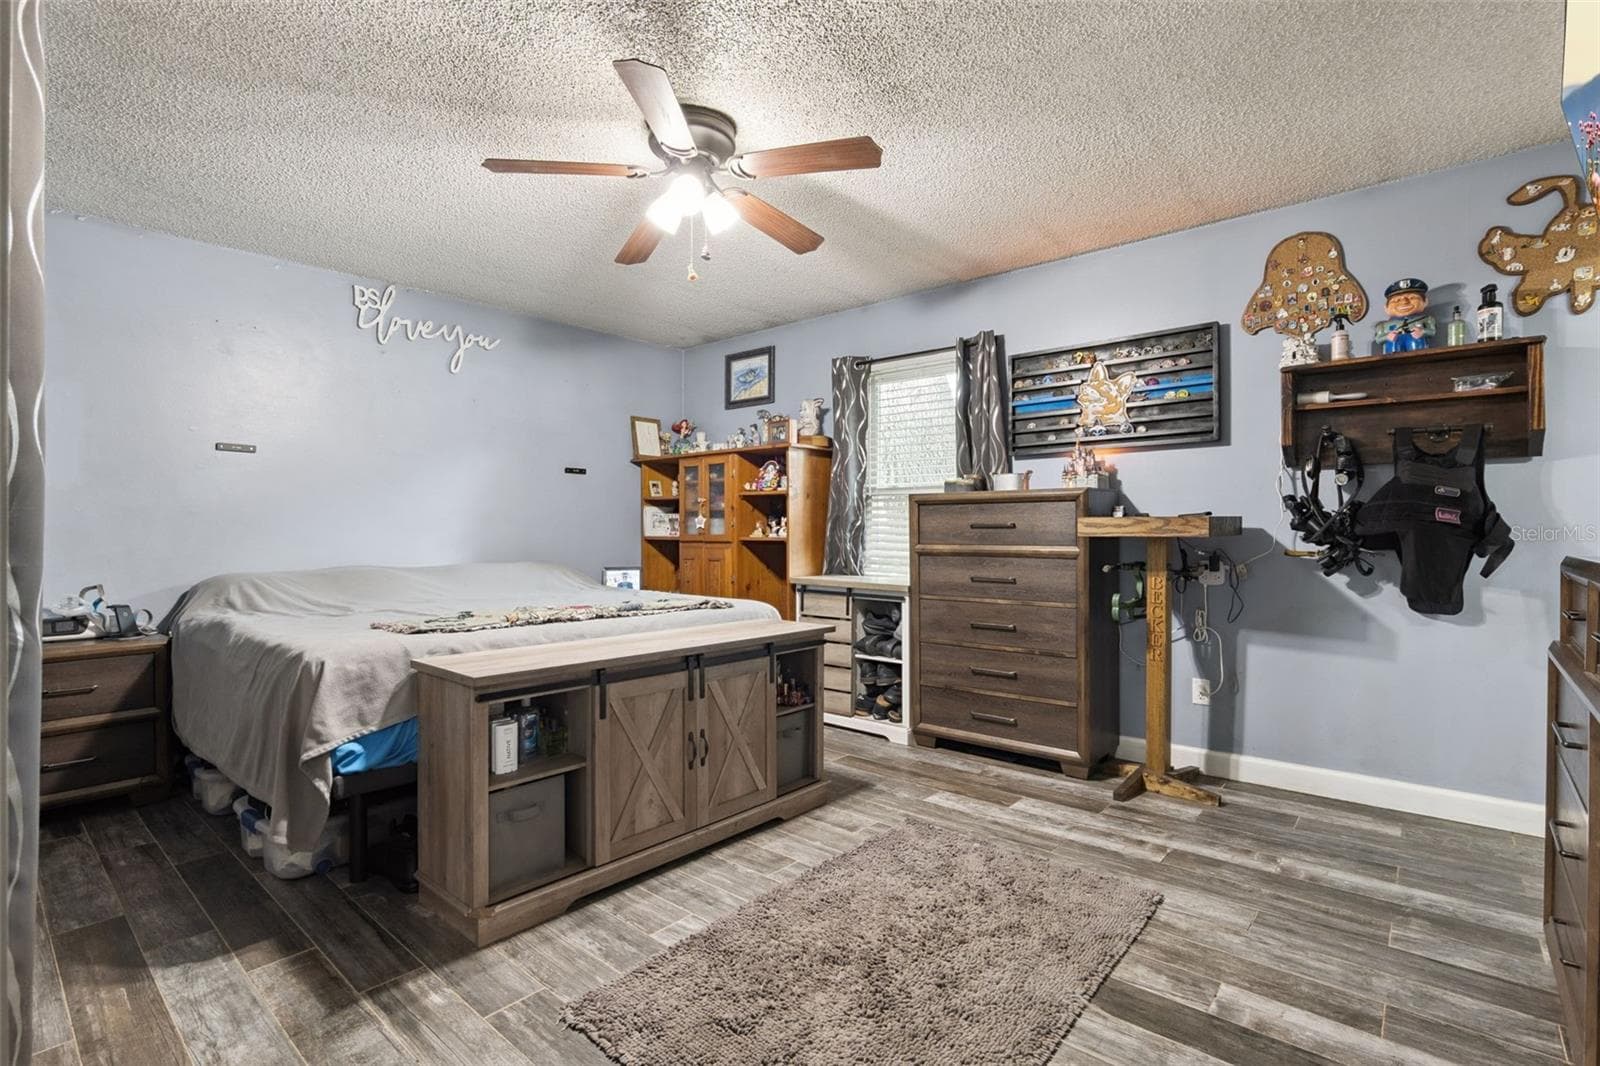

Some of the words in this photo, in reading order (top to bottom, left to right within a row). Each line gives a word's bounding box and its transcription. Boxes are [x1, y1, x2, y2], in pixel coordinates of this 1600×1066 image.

[352, 285, 380, 307] PS
[377, 285, 439, 344] love
[440, 324, 501, 374] you
[1151, 576, 1164, 662] BECKER
